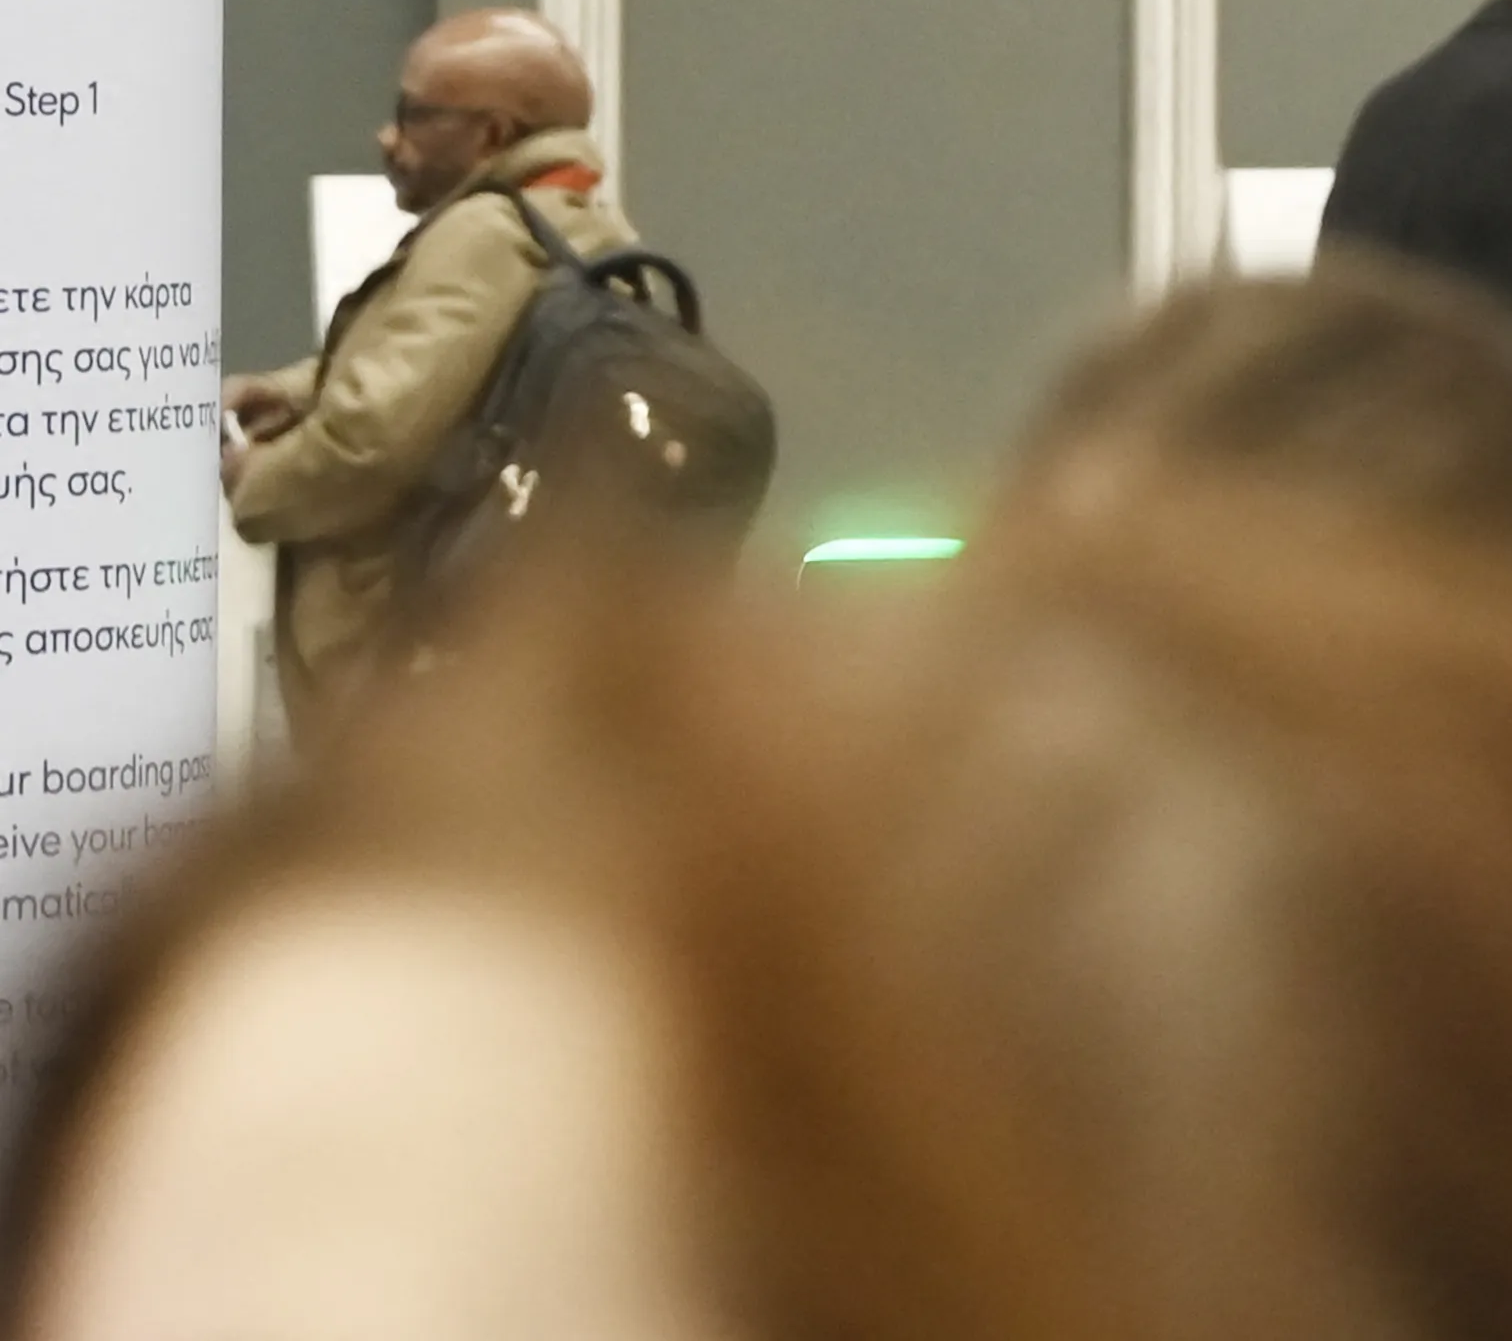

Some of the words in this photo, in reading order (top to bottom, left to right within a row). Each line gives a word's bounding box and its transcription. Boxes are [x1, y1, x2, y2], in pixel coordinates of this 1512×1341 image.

[5, 81, 80, 127] Step
[88, 80, 97, 115] 1
[62, 284, 117, 323] την
[125, 270, 193, 320] κάρτα
[74, 346, 132, 382] σας
[138, 342, 174, 382] για
[42, 408, 99, 447] την
[107, 392, 194, 434] ετικέτα
[68, 469, 133, 505] σας.
[0, 555, 90, 605] ήστε
[99, 561, 147, 600] την
[26, 608, 186, 658] αποσκευής
[43, 752, 174, 797] boarding
[70, 821, 138, 866] your
